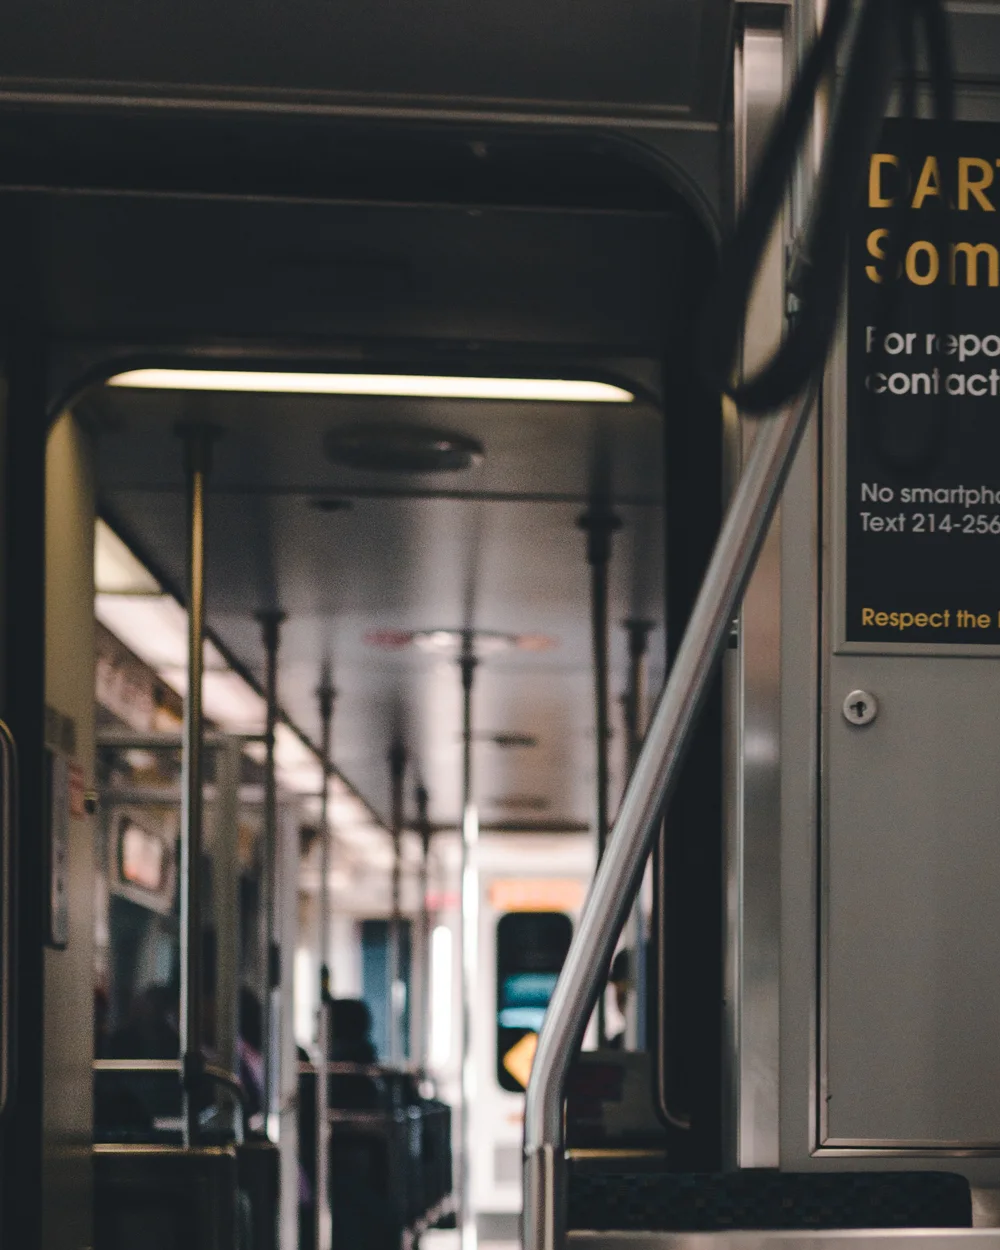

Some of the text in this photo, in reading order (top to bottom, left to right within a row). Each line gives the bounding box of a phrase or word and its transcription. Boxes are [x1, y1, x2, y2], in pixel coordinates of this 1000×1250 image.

[860, 482, 895, 504] No
[859, 511, 907, 533] Text
[861, 607, 951, 631] Respect
[956, 609, 991, 629] the
